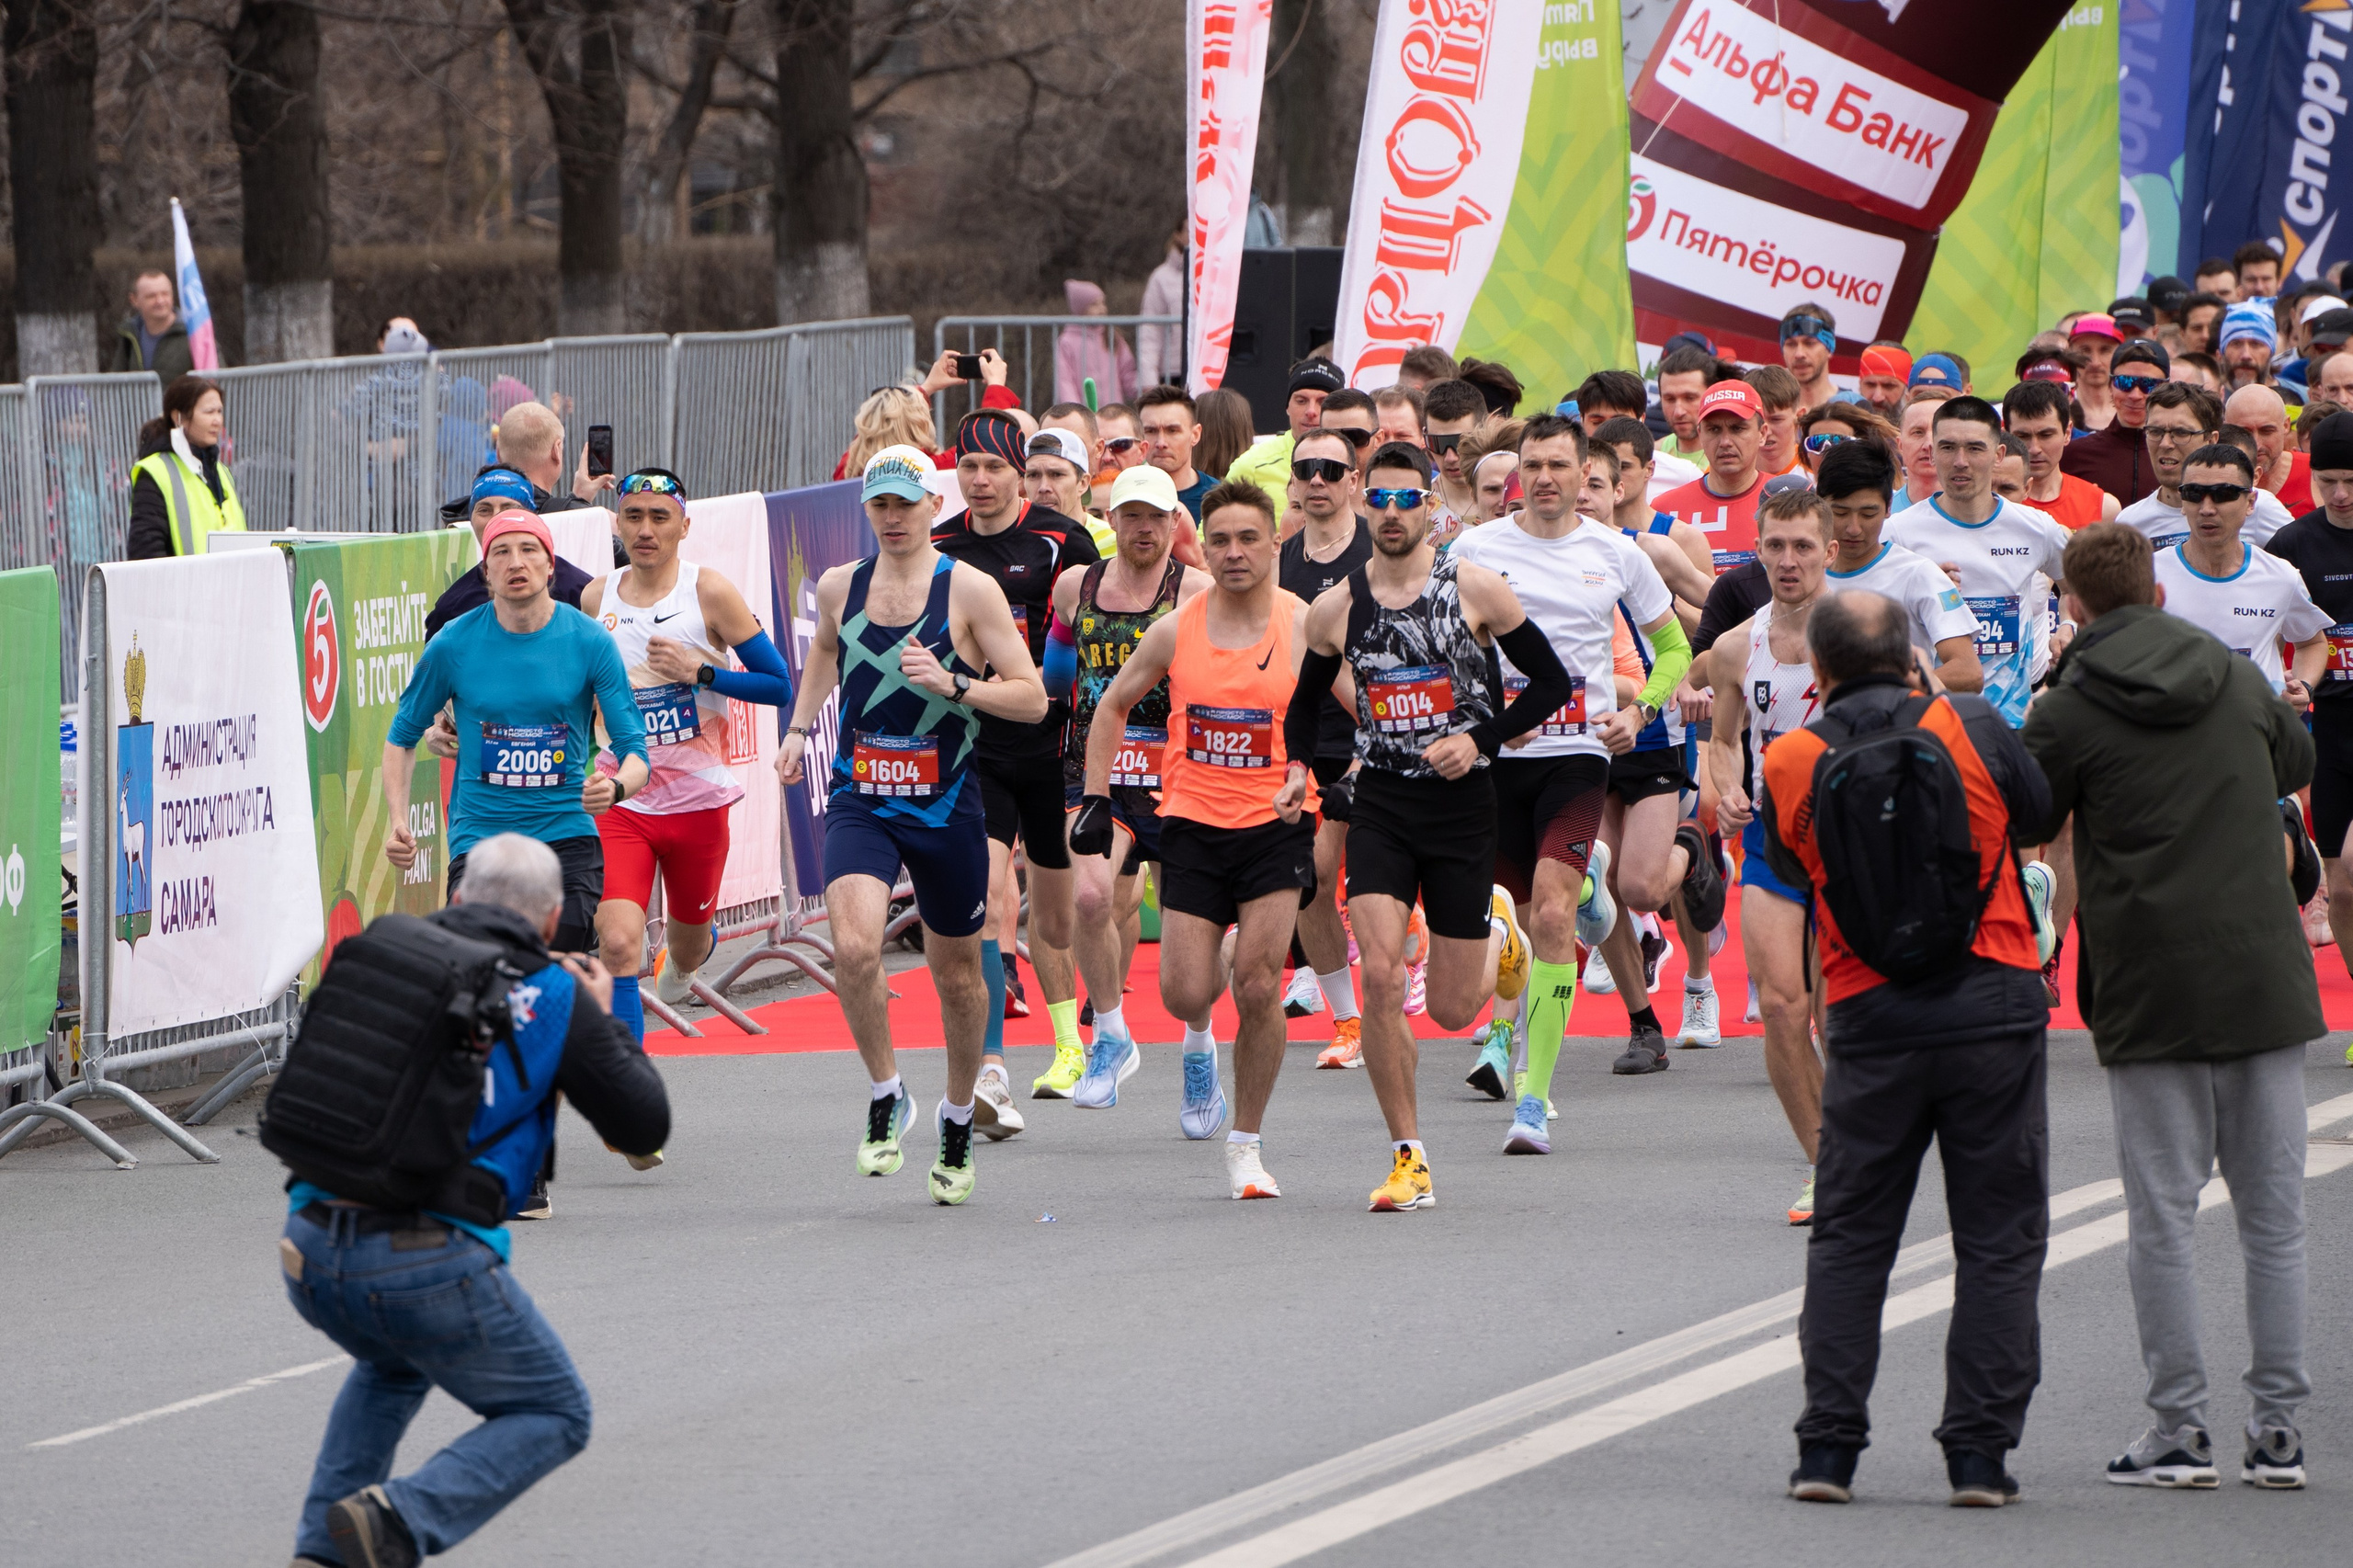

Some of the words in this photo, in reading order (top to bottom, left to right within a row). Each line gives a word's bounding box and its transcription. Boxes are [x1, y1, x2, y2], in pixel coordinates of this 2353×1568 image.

[1678, 7, 1820, 117] Альфа
[1825, 82, 1947, 170] Банк
[1659, 208, 1884, 307] Пятёрочка
[1703, 390, 1745, 406] RUSSIA
[1990, 547, 2014, 556] RUN
[2016, 547, 2029, 555] KZ
[354, 580, 426, 650] ЗАБЕГАЙТЕ
[2234, 608, 2257, 617] RUN
[2260, 608, 2275, 618] KZ
[1978, 619, 2004, 642] 94
[2338, 647, 2353, 667] 13
[357, 658, 366, 708] В
[369, 651, 414, 706] ГОСТИ
[1386, 691, 1434, 717] 1014
[644, 707, 680, 733] 021
[162, 713, 256, 780] АДМИНИСТРАЦИЯ
[1204, 730, 1252, 755] 1822
[496, 749, 552, 773] 2006
[869, 759, 920, 782] 1604
[1111, 750, 1149, 773] 204
[161, 791, 233, 853] ГОРОДСКОГО
[234, 786, 275, 835] ОКРУГА
[408, 801, 436, 839] OLGA
[161, 875, 217, 936] САМАРА
